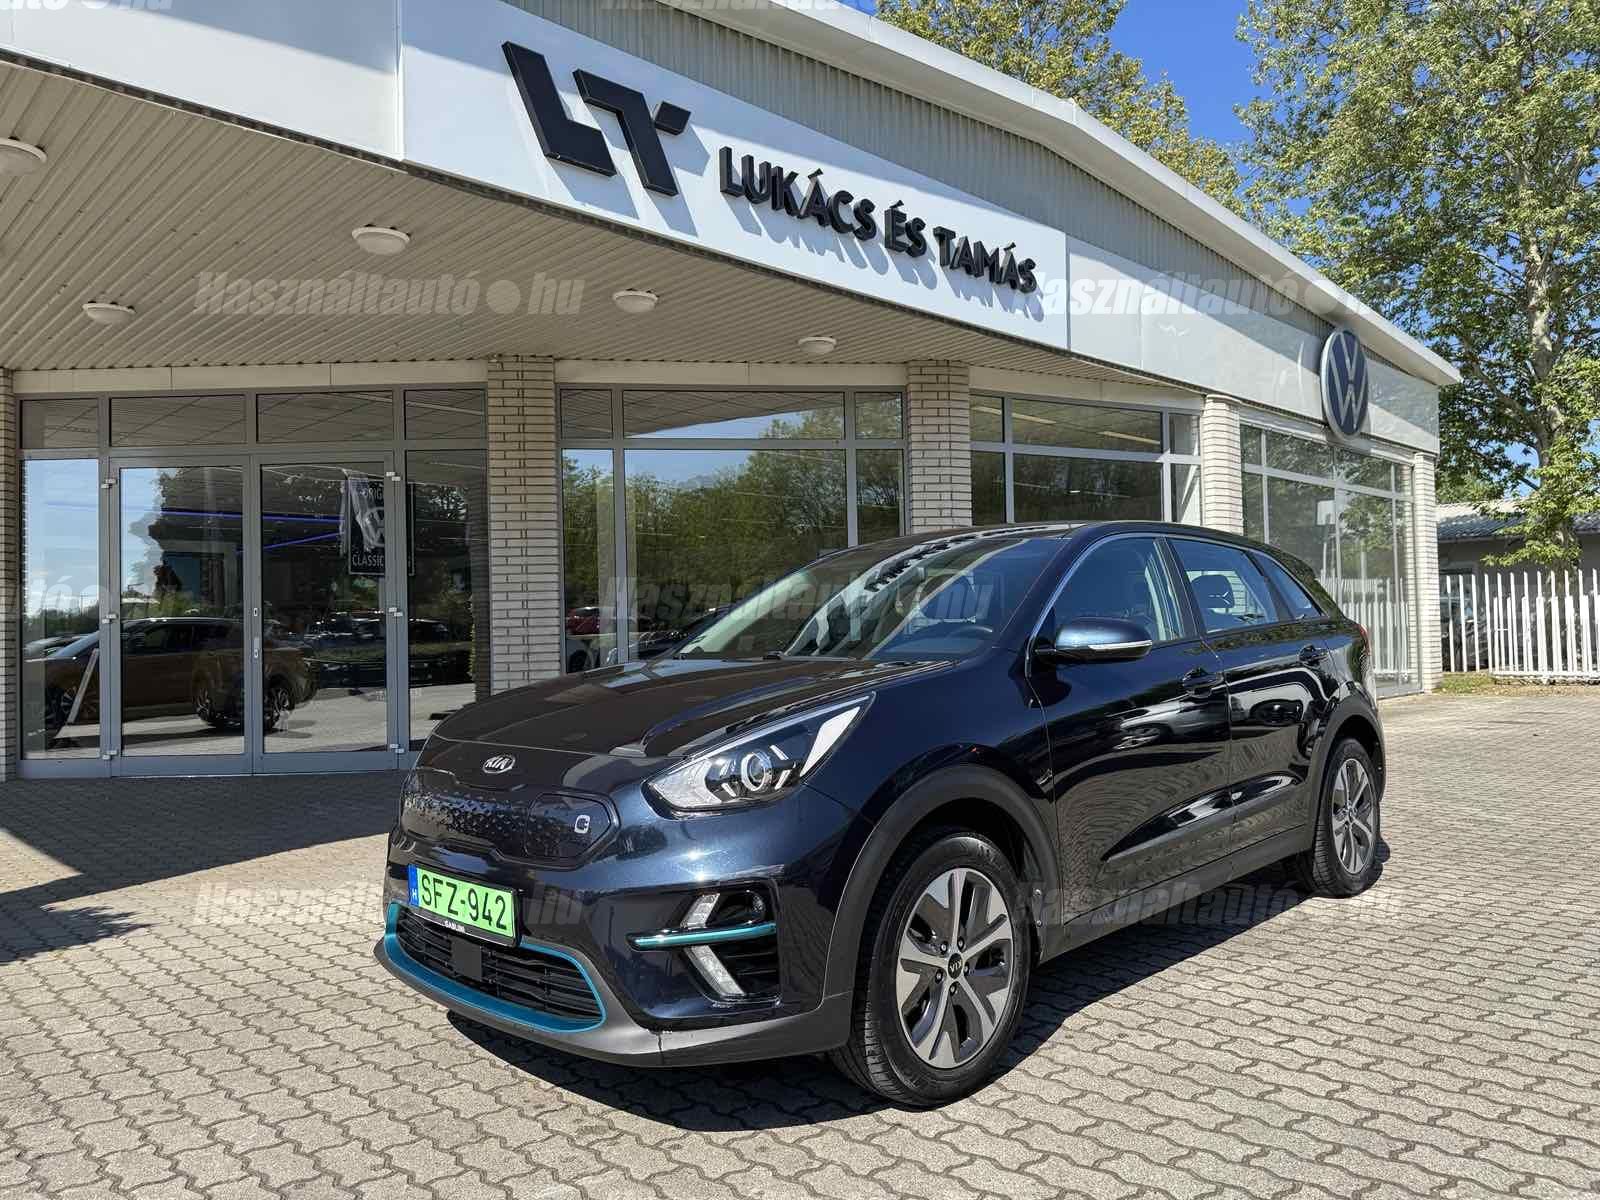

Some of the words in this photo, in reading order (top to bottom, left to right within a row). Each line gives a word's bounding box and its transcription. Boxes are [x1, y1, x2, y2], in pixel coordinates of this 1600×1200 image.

[719, 146, 877, 241] LUKÁCS
[884, 200, 927, 258] ÉS
[933, 226, 1037, 293] TAMÁS
[421, 873, 508, 931] SFZ-942
